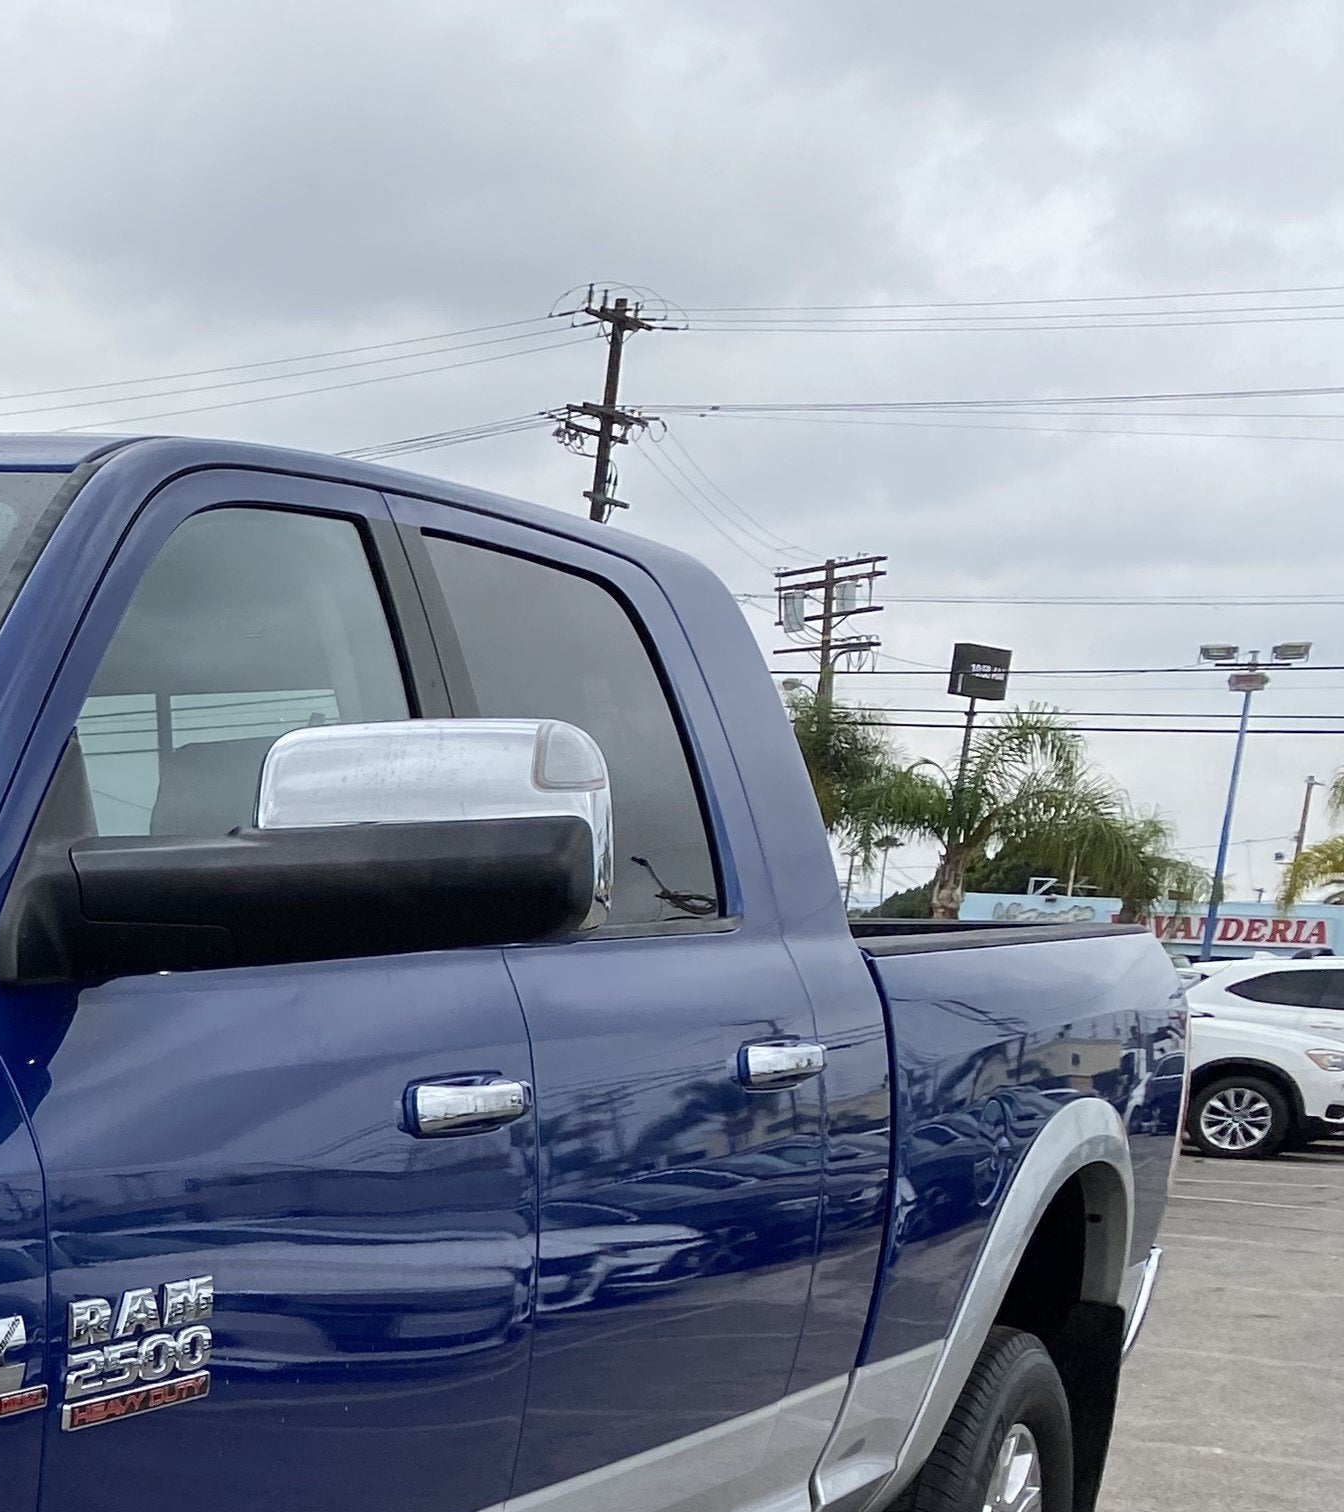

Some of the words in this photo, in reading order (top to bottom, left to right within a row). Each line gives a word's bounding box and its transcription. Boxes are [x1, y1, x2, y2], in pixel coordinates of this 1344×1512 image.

[68, 1274, 214, 1349] RAM
[65, 1325, 212, 1400] 2500
[72, 1390, 145, 1427] HEAVY
[148, 1376, 207, 1405] DUTY
